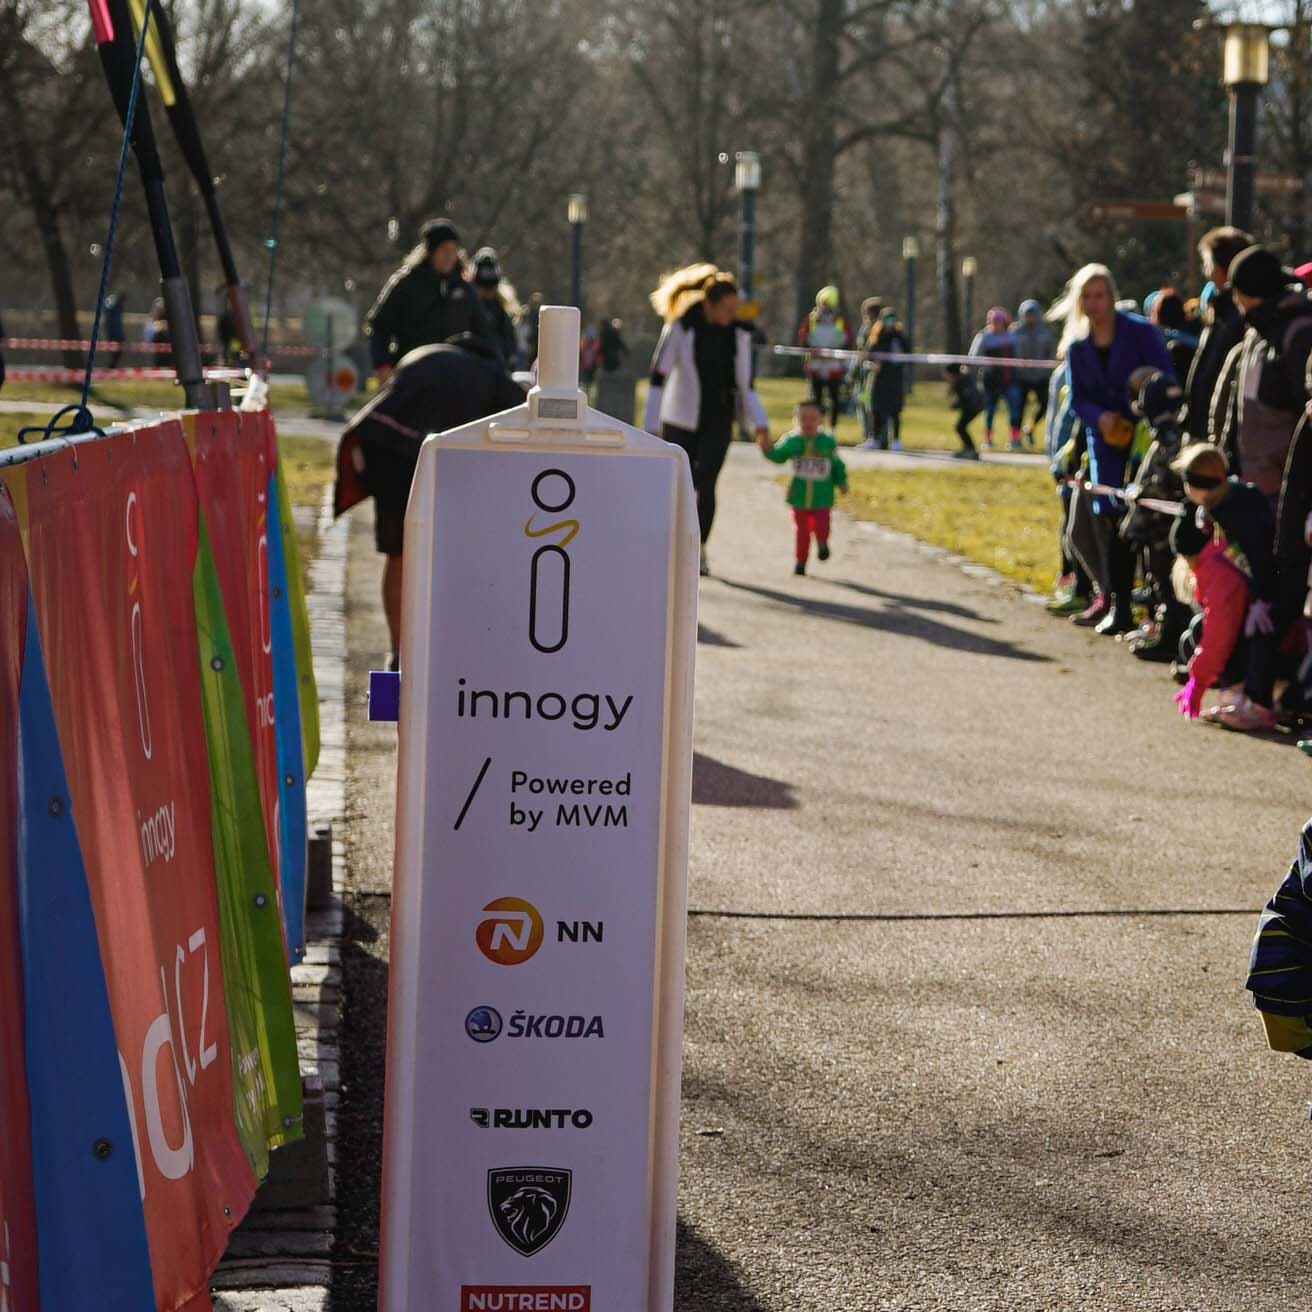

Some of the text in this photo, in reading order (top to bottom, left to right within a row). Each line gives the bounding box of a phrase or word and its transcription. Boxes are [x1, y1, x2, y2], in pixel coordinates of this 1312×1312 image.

[458, 678, 634, 731] innogy
[511, 771, 631, 796] Powered
[510, 801, 628, 832] by MVM
[557, 921, 604, 942] NN
[507, 1009, 605, 1038] ŠKODA
[494, 1109, 593, 1129] RUNTO
[495, 1174, 564, 1185] PEUGEOT
[468, 1292, 585, 1311] NUTREND
